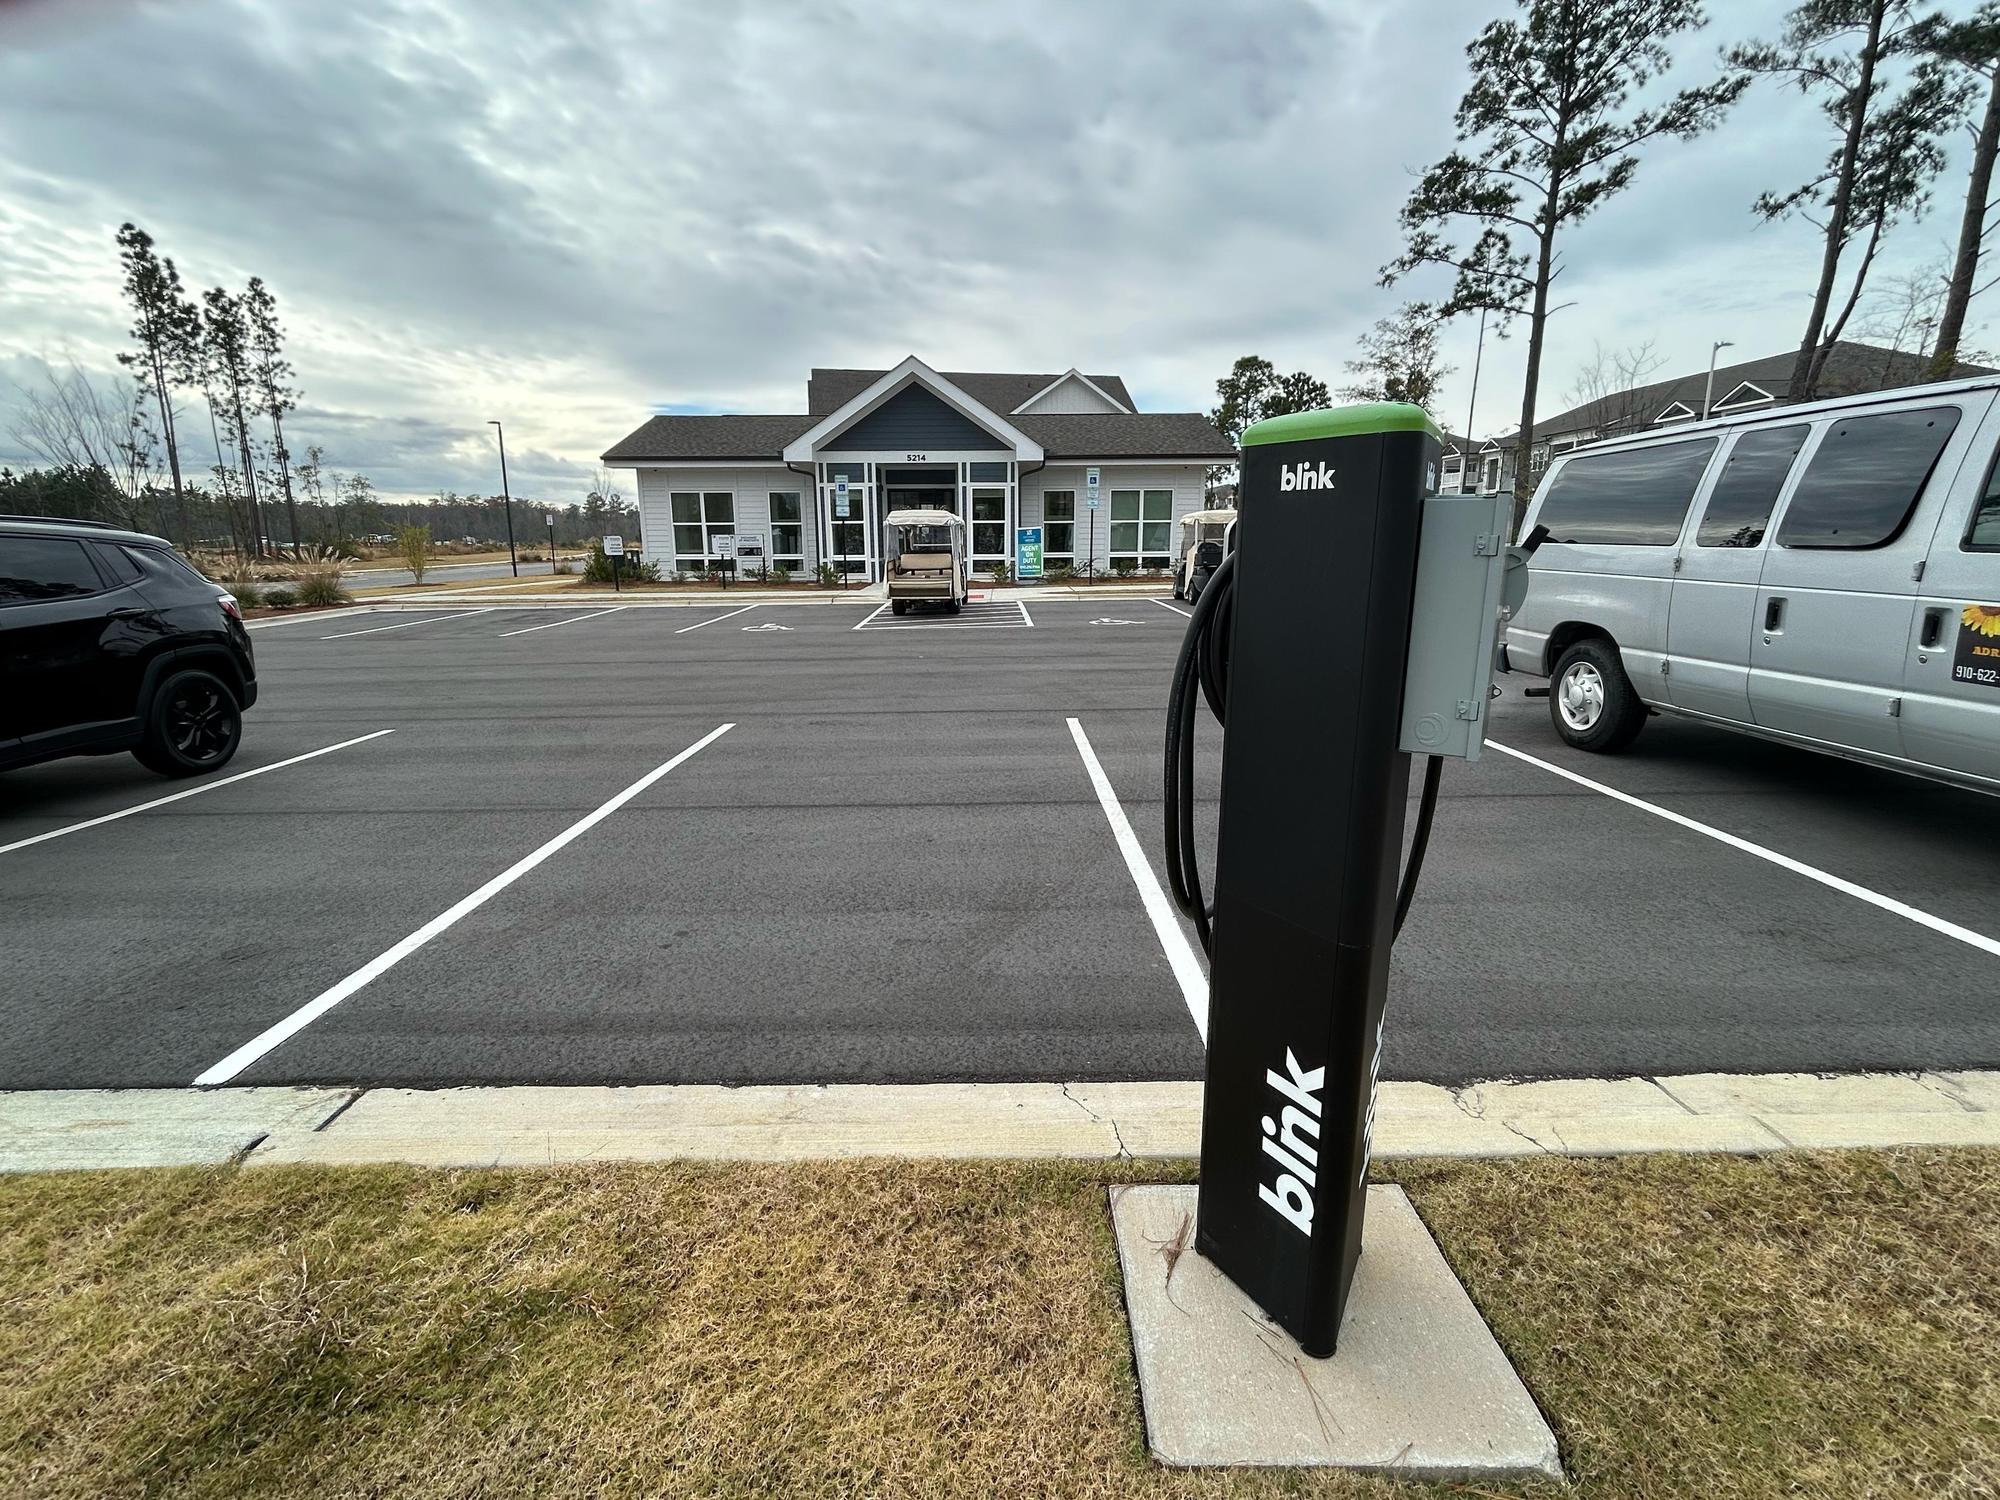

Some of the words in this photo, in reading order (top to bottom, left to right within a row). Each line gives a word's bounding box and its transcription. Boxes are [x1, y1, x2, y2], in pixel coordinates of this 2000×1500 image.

[906, 454, 926, 462] 5214
[1280, 461, 1336, 492] blink
[1258, 1045, 1326, 1237] blink
